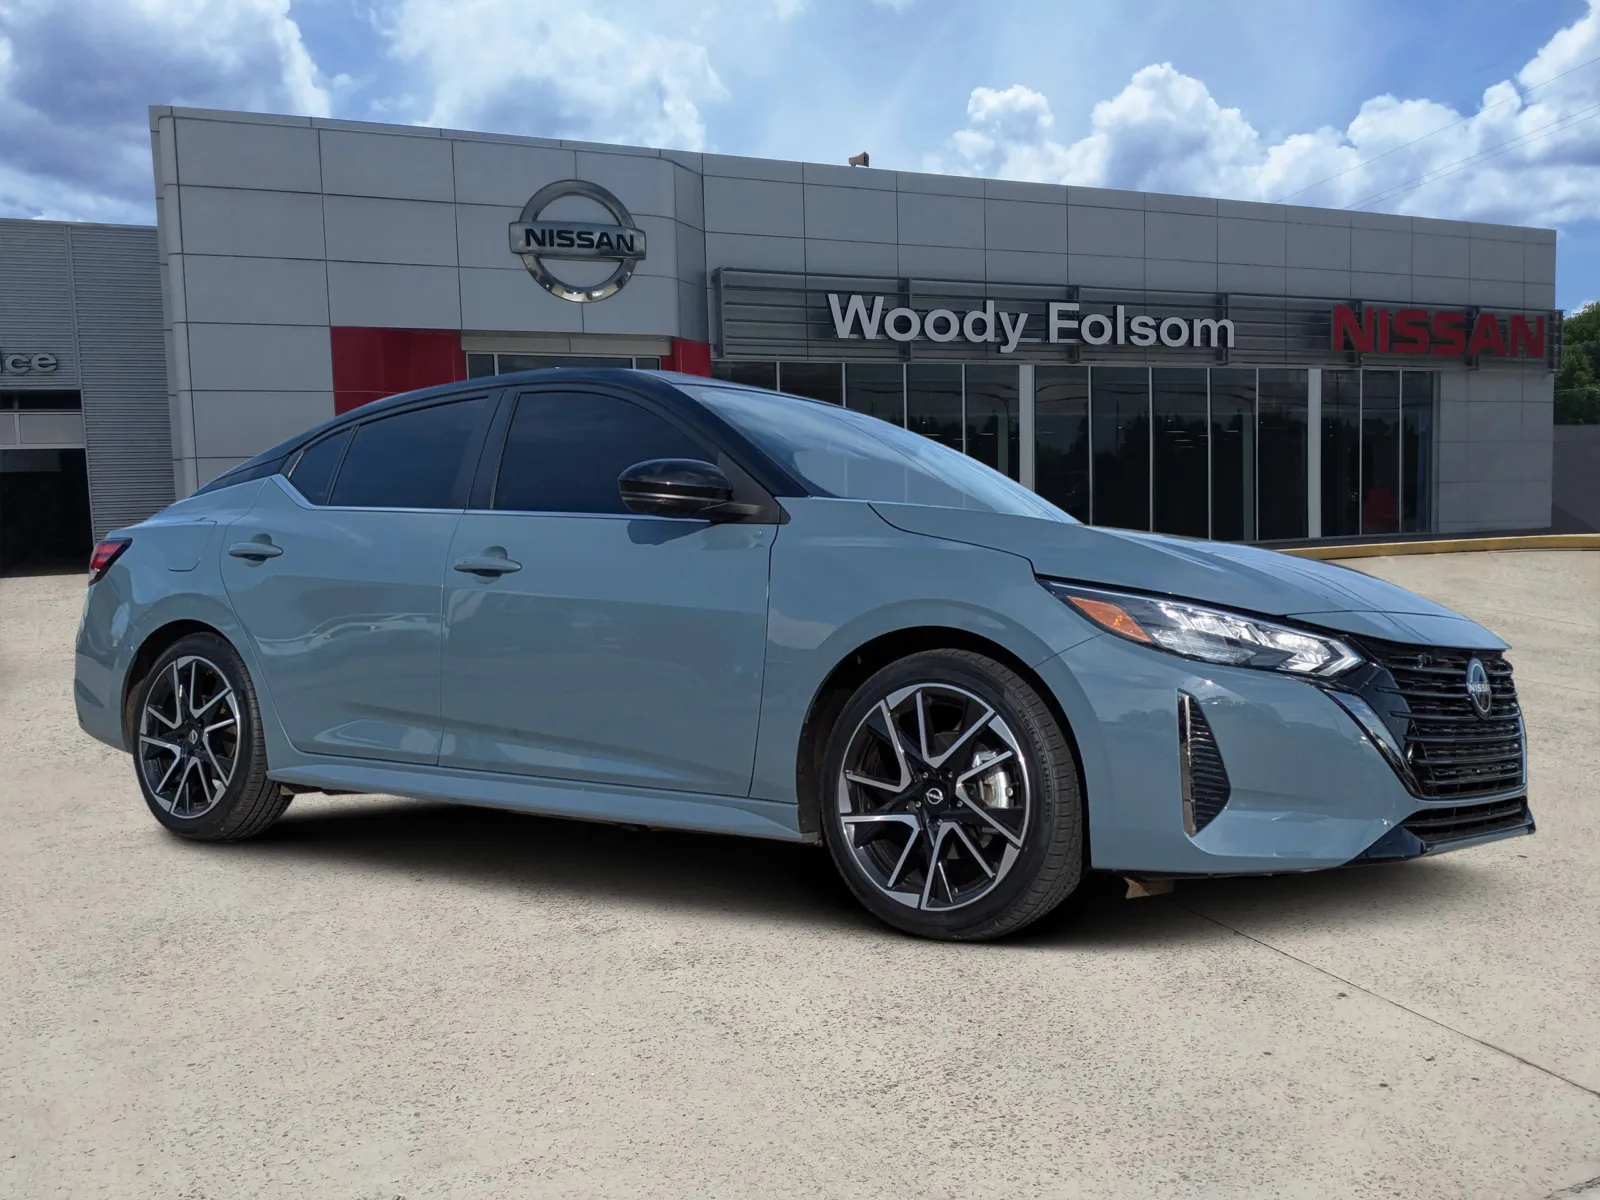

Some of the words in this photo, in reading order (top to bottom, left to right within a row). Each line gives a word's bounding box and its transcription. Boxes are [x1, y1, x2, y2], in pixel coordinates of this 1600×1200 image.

[524, 228, 635, 252] NISSAN
[827, 293, 1028, 353] Woody
[1049, 302, 1235, 348] Folsom
[1333, 305, 1545, 358] NISSAN
[0, 353, 57, 373] ce
